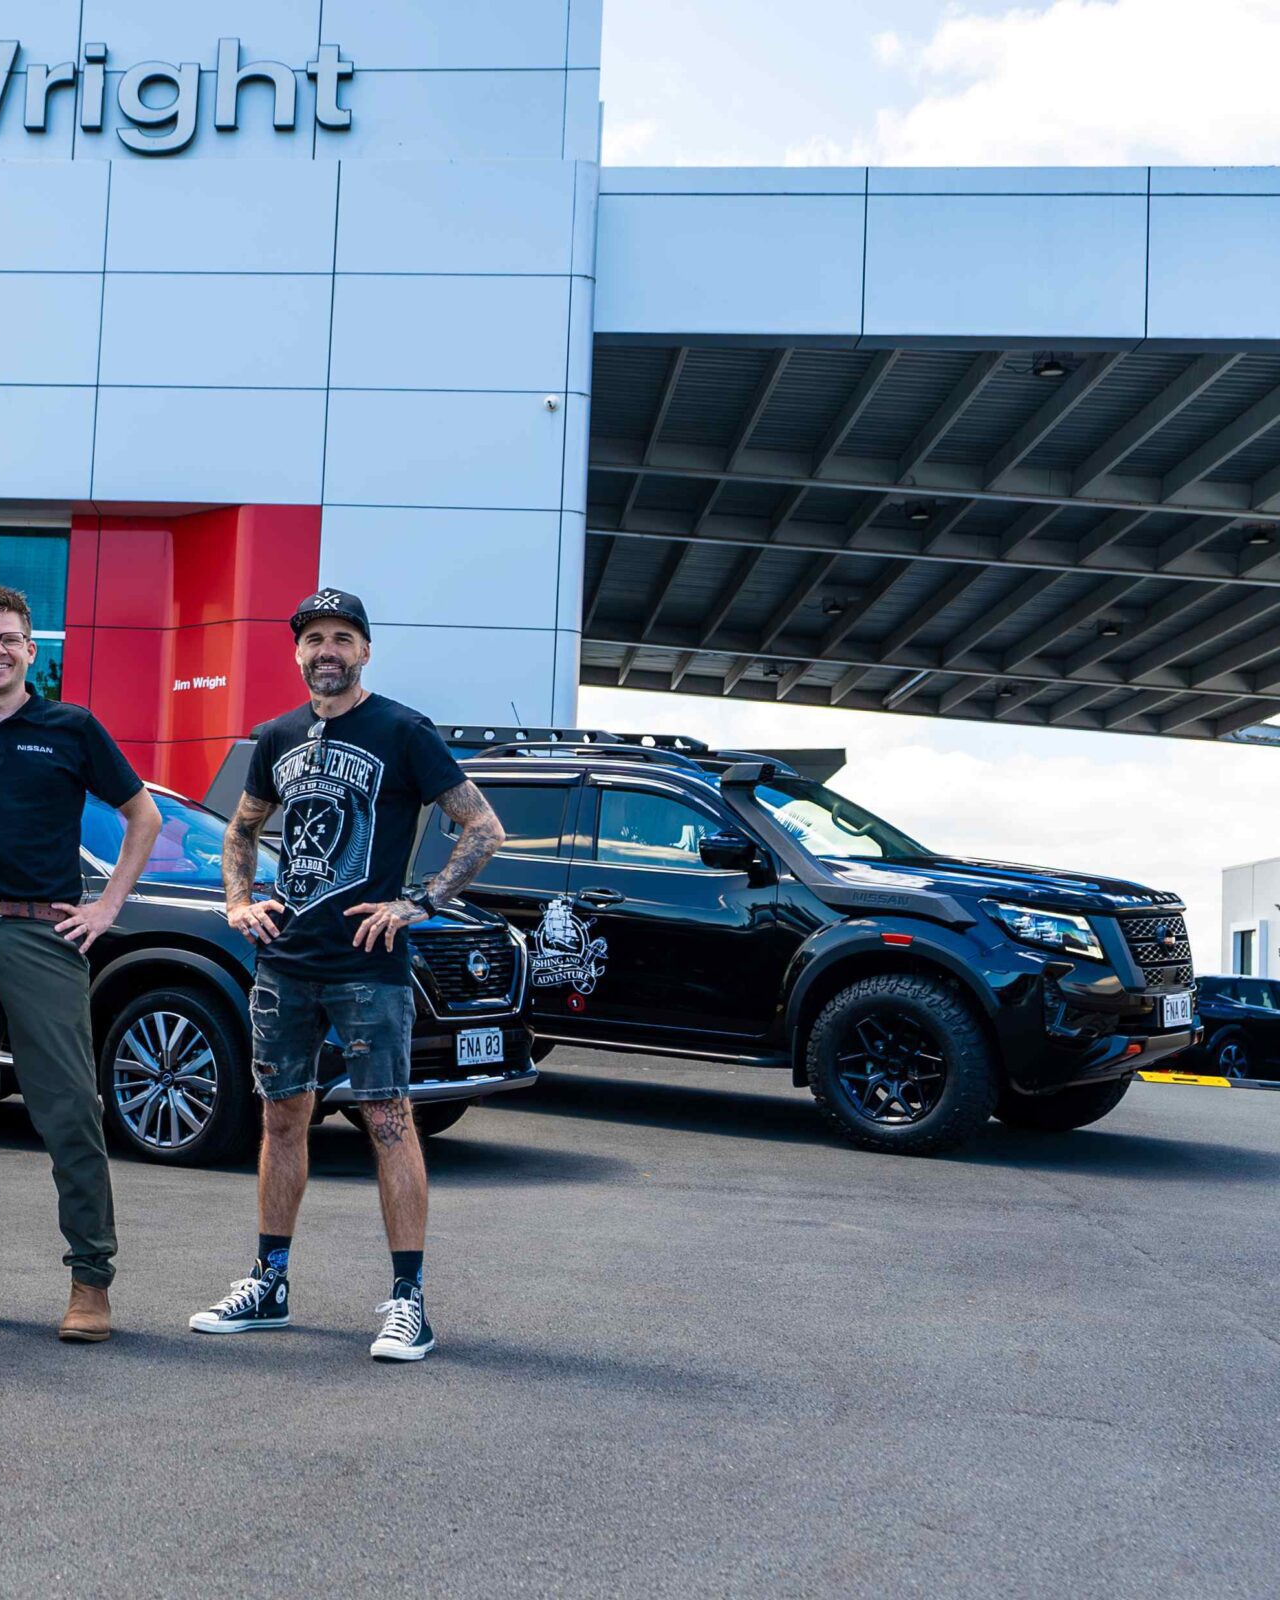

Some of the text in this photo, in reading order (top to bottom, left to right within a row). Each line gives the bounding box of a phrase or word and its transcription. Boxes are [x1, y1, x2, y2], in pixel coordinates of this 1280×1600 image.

[173, 675, 227, 691] Jim Wright
[17, 744, 53, 754] NISSAN
[852, 891, 910, 905] NISSAN
[565, 956, 581, 964] AND
[537, 971, 590, 985] ADVENTURE
[1166, 1000, 1189, 1021] FNA 01
[460, 1035, 500, 1059] FNA 03
